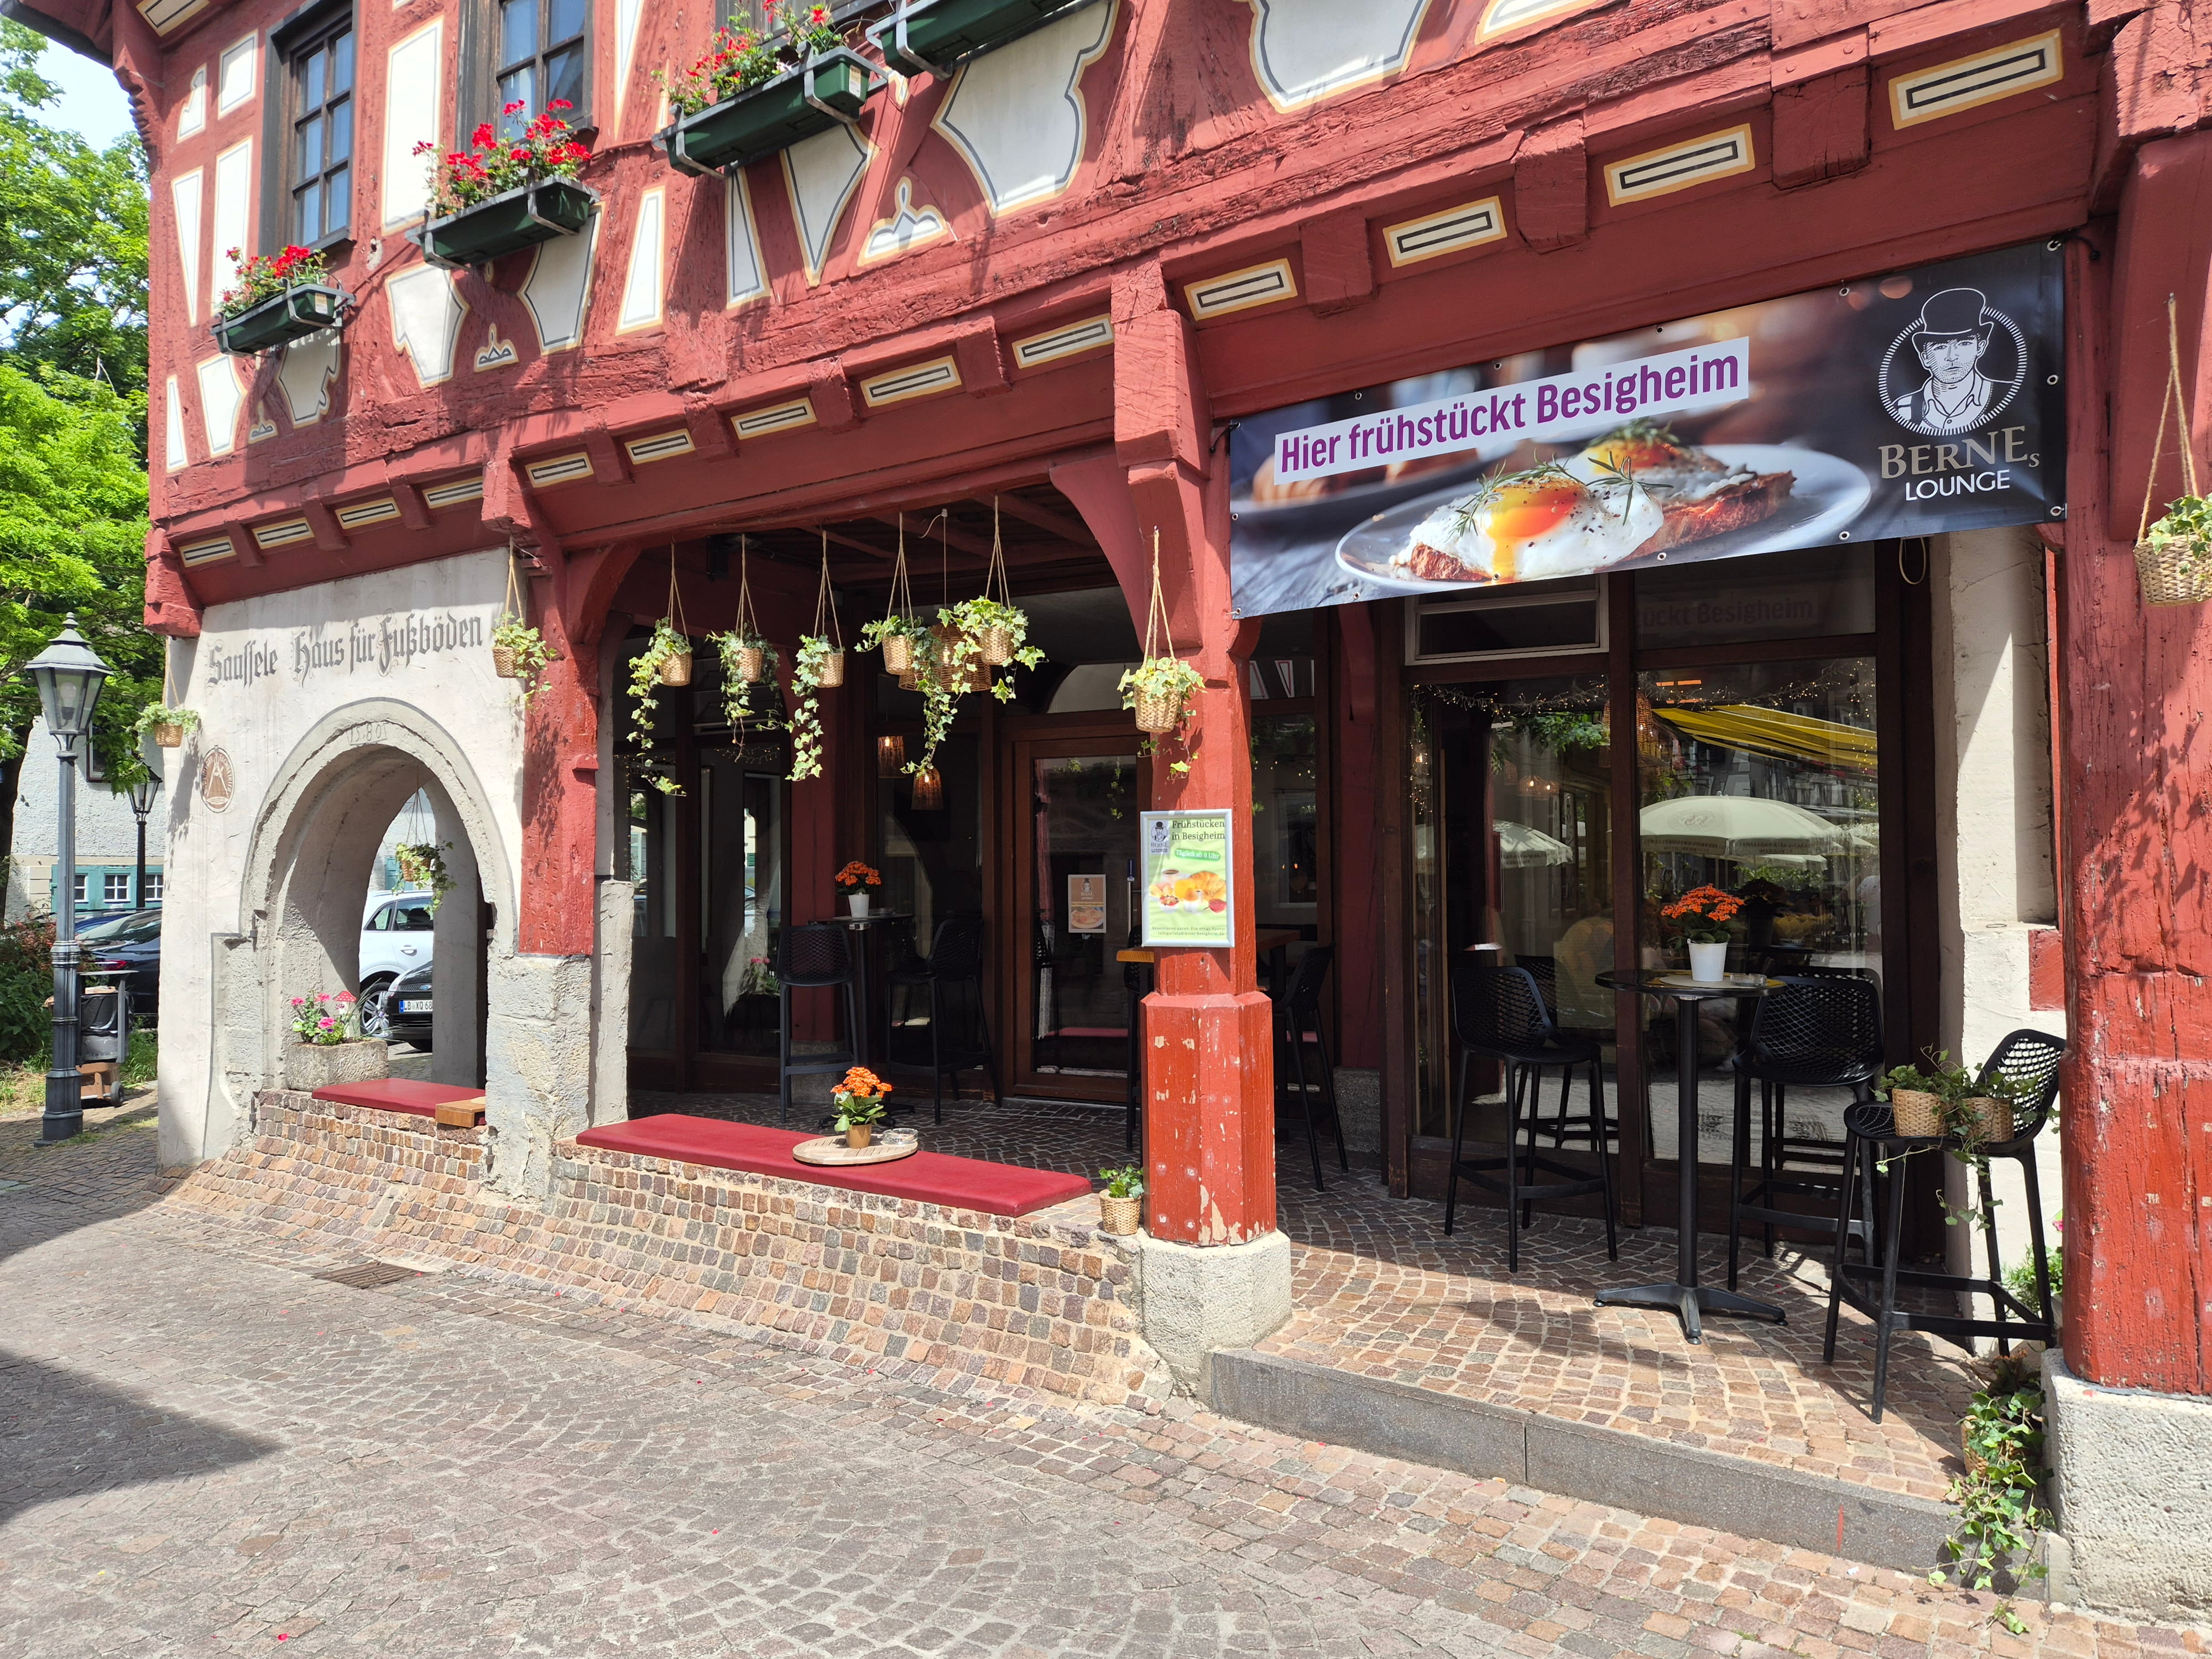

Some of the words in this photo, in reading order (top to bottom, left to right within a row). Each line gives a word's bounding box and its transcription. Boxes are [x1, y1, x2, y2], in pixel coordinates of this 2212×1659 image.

[1281, 434, 1341, 473] Hier
[1349, 392, 1526, 460] frühstückt
[1537, 354, 1738, 424] Besigheim
[1906, 469, 2010, 501] LOUNGE
[292, 629, 344, 688] Haus
[349, 622, 375, 676] für
[377, 608, 483, 676] Fußböden
[1172, 820, 1225, 829] Frühstücken
[1182, 832, 1225, 842] Besigheim
